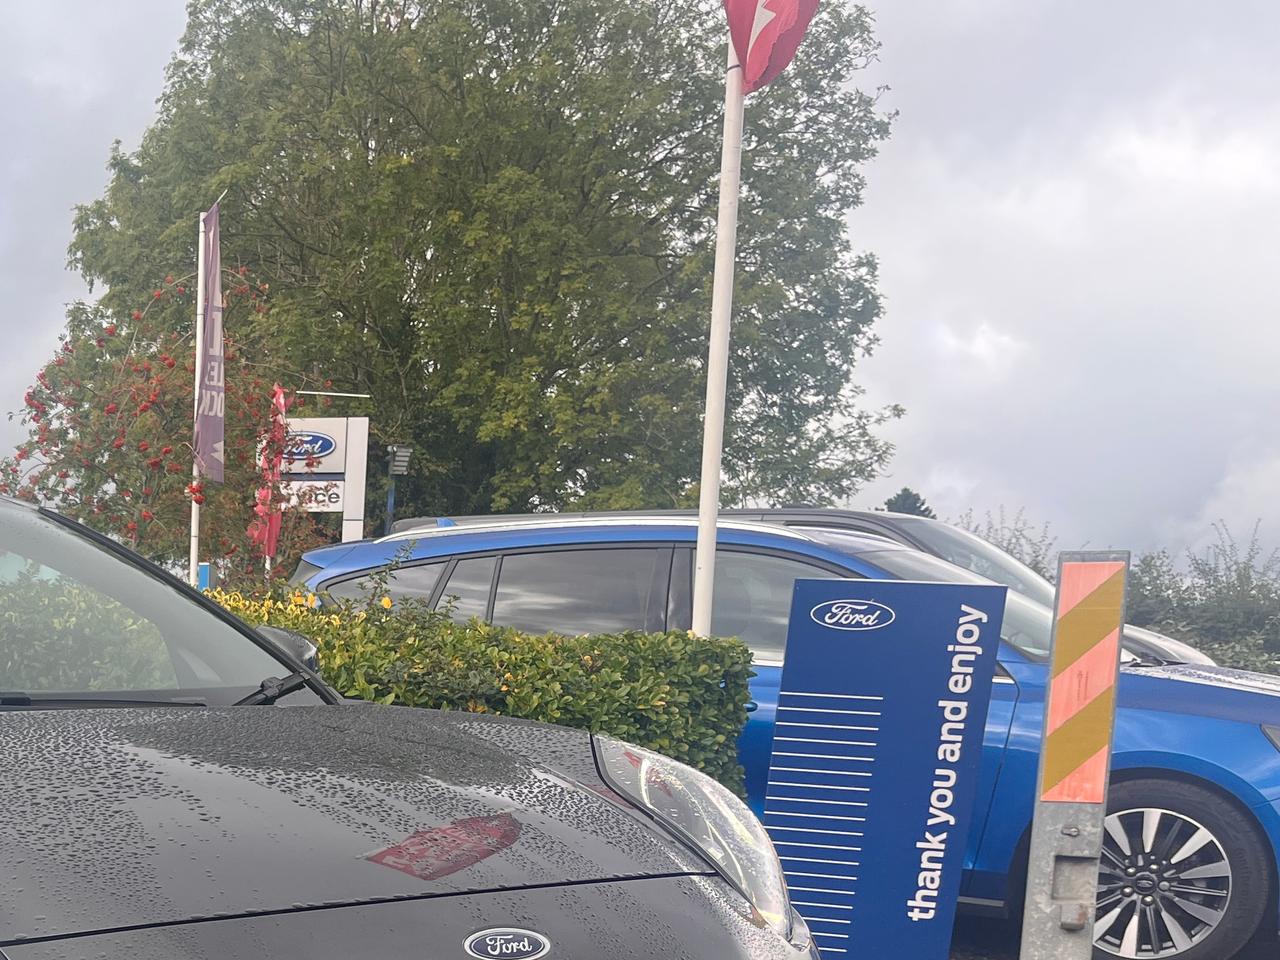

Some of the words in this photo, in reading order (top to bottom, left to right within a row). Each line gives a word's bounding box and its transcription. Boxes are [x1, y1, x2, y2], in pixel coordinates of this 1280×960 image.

[824, 603, 881, 625] Ford
[947, 604, 988, 694] enjoy
[937, 700, 968, 763] and
[926, 768, 956, 826] you
[907, 831, 948, 921] thank
[485, 935, 533, 955] Ford
